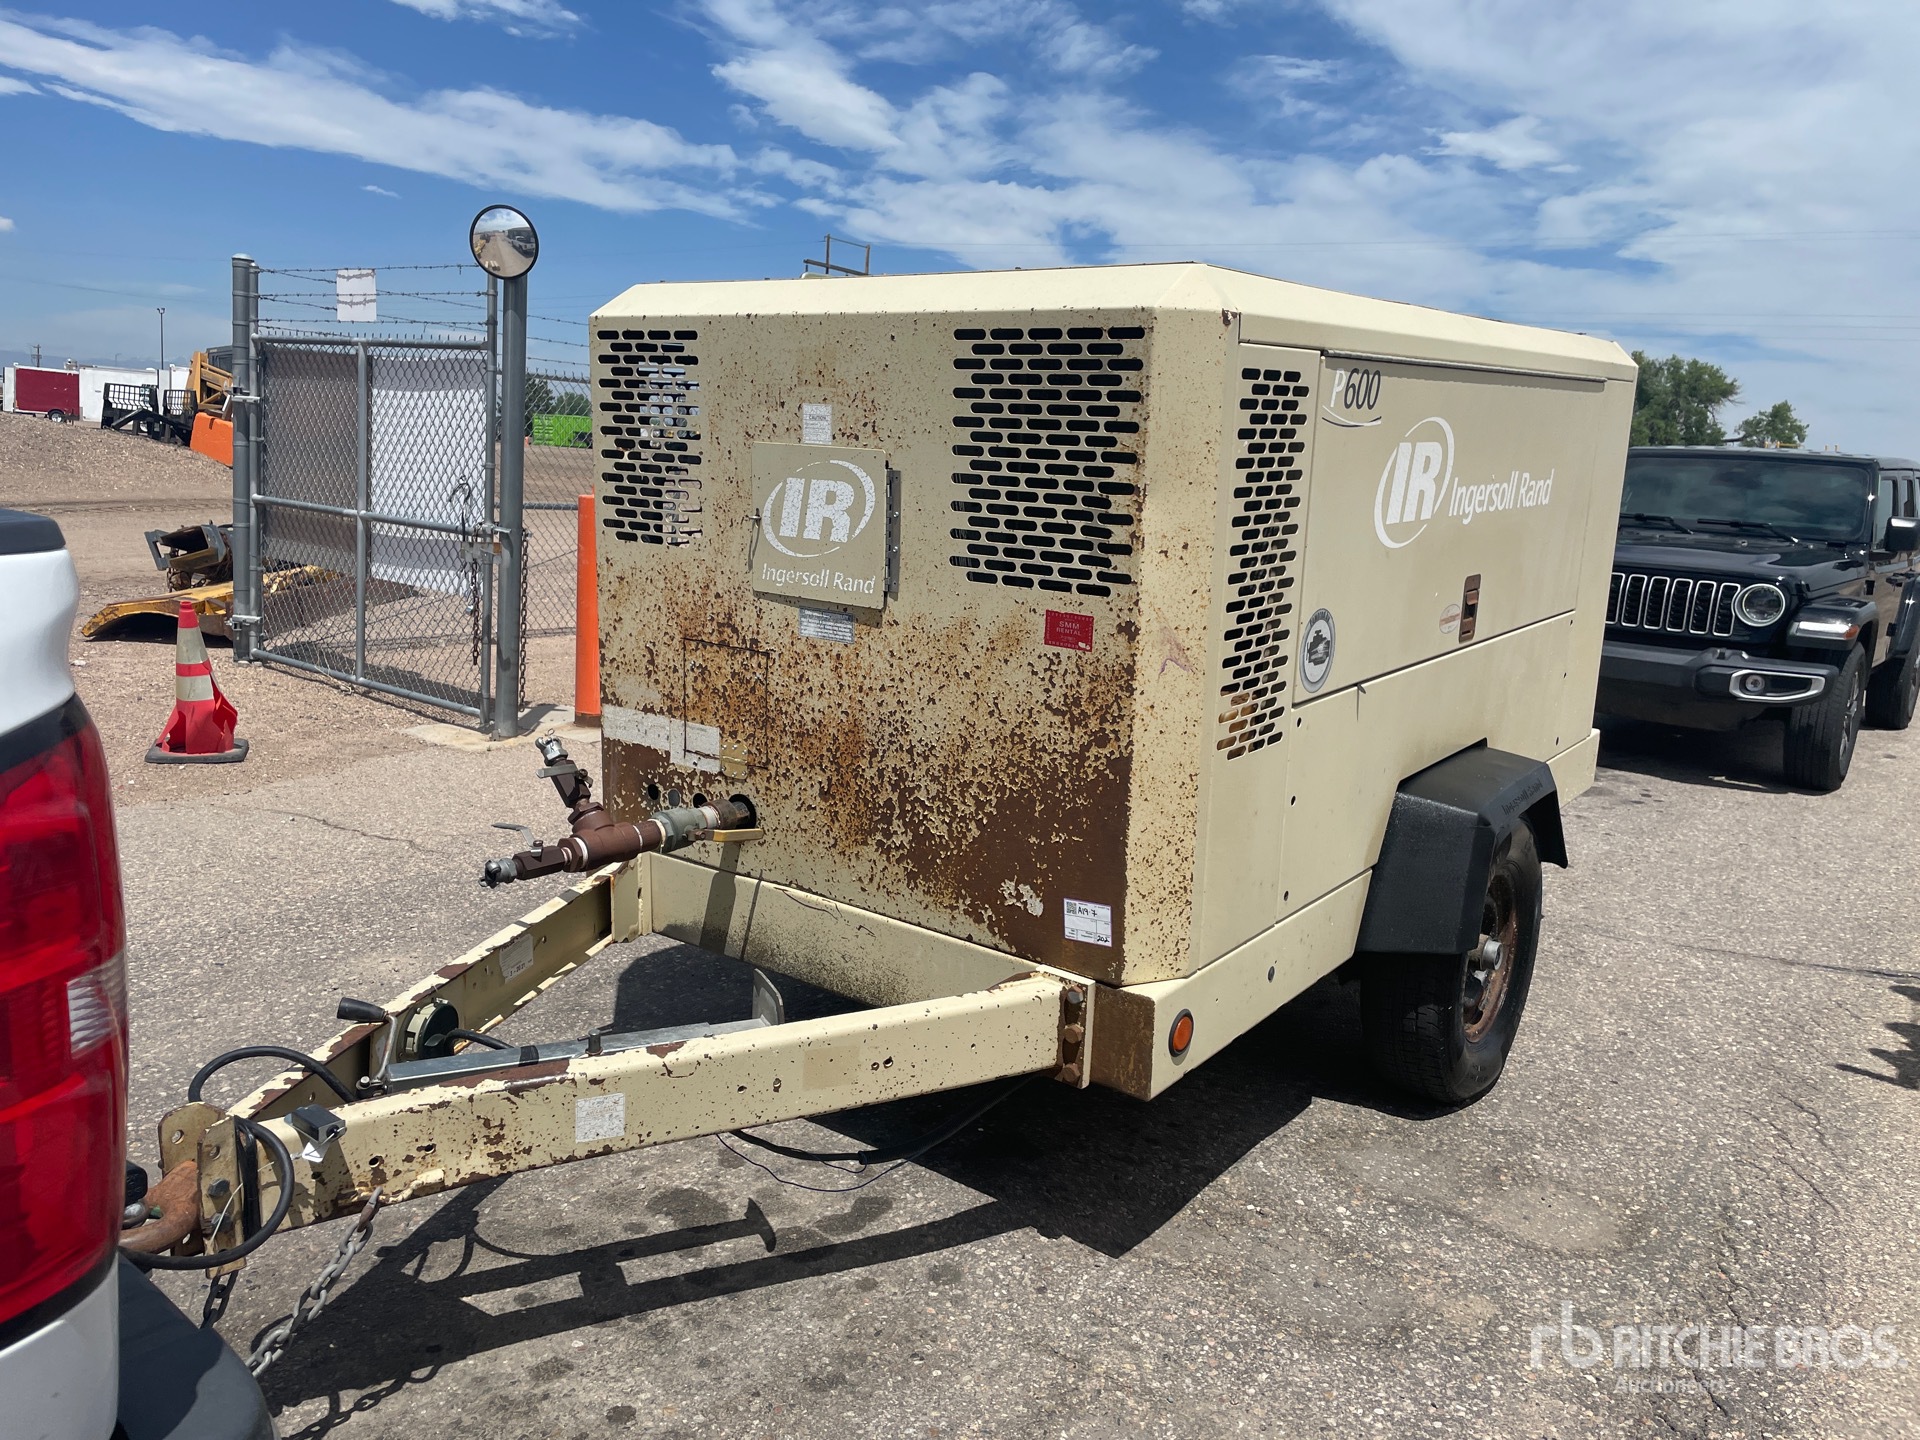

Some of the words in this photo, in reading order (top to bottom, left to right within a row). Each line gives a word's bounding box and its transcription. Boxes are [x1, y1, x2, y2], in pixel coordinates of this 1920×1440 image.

[1330, 367, 1381, 411] P600
[1386, 441, 1443, 525] IR
[1448, 470, 1519, 525] Ingersoll
[1517, 468, 1555, 509] Rand
[779, 477, 855, 543] IR
[762, 563, 829, 588] Ingersoll
[833, 571, 875, 594] Rand
[1056, 627, 1081, 636] RENTAL
[1059, 620, 1080, 630] SMM
